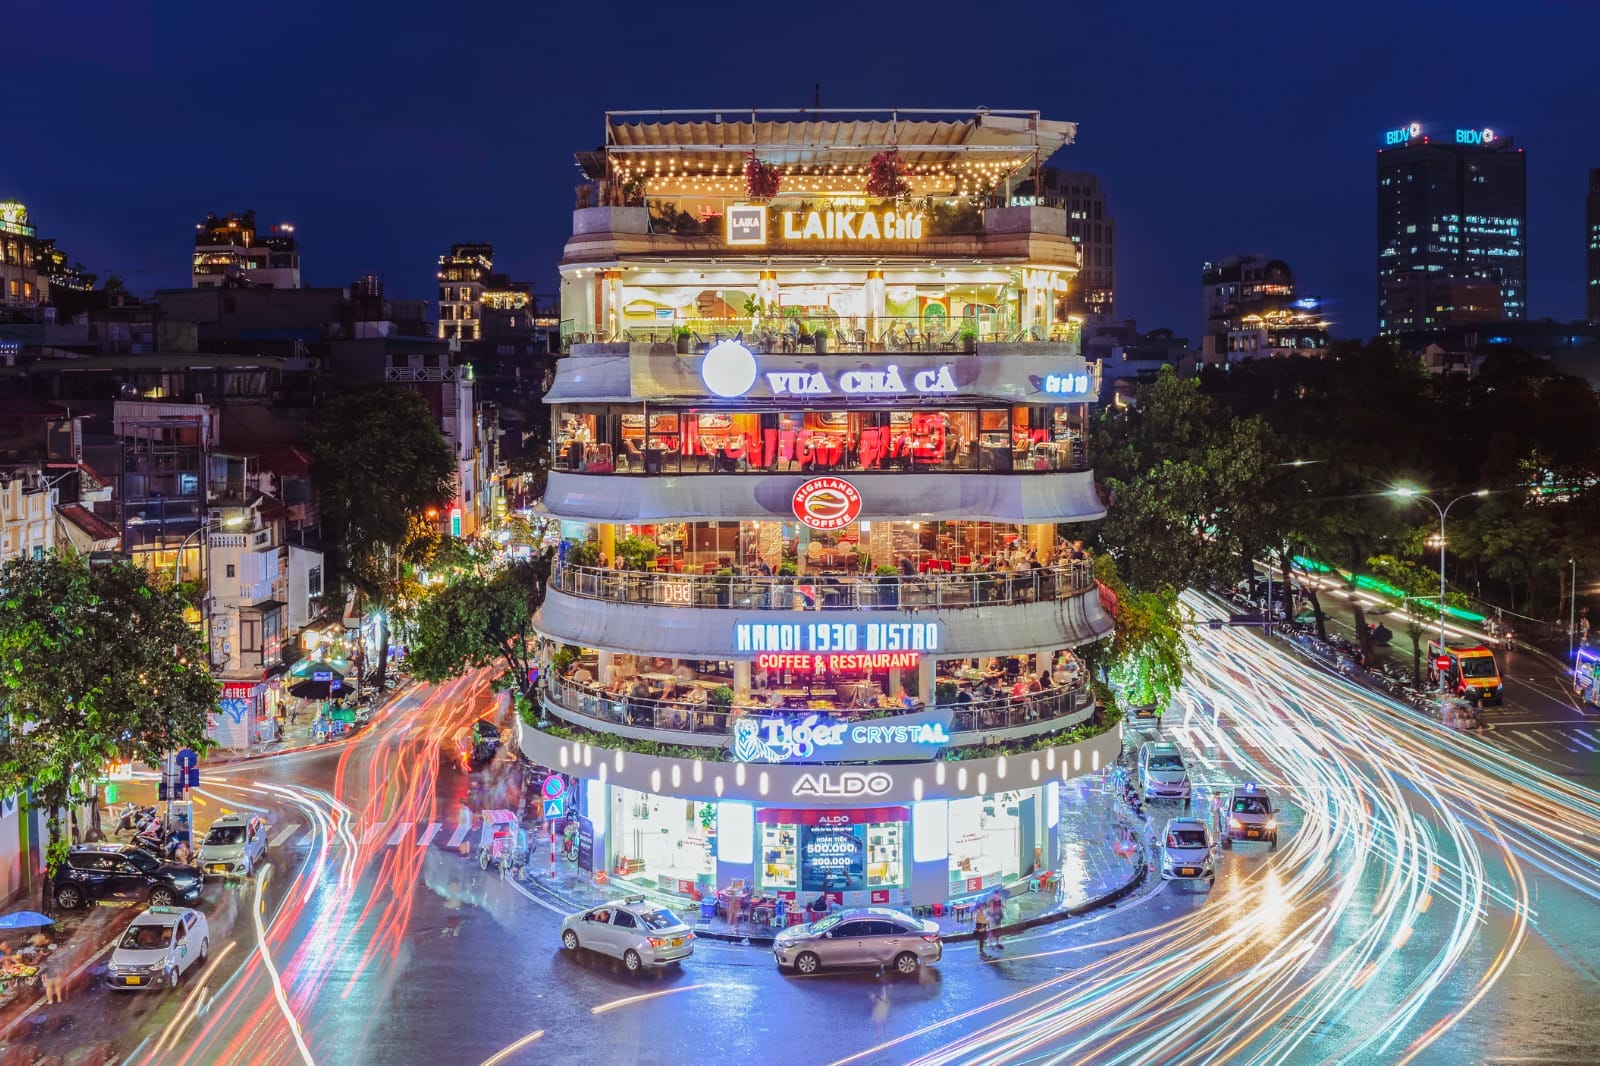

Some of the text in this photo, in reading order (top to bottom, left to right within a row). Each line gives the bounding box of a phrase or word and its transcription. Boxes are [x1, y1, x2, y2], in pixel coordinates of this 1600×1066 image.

[1386, 127, 1410, 145] BIDV
[1456, 129, 1482, 144] BIDV
[732, 217, 760, 228] LAIKA
[784, 211, 881, 239] LAIKA
[766, 373, 832, 394] VUA
[796, 480, 858, 502] HIGHLANDS
[803, 514, 851, 528] COFFEE
[737, 623, 938, 651] HANOI 1930 BISTRO
[759, 652, 919, 669] COFFEE & RESTAURANT
[233, 688, 247, 698] FREE
[761, 715, 950, 758] Tiger CRYSTAL
[793, 774, 893, 796] ALDO
[819, 815, 849, 823] ALDO
